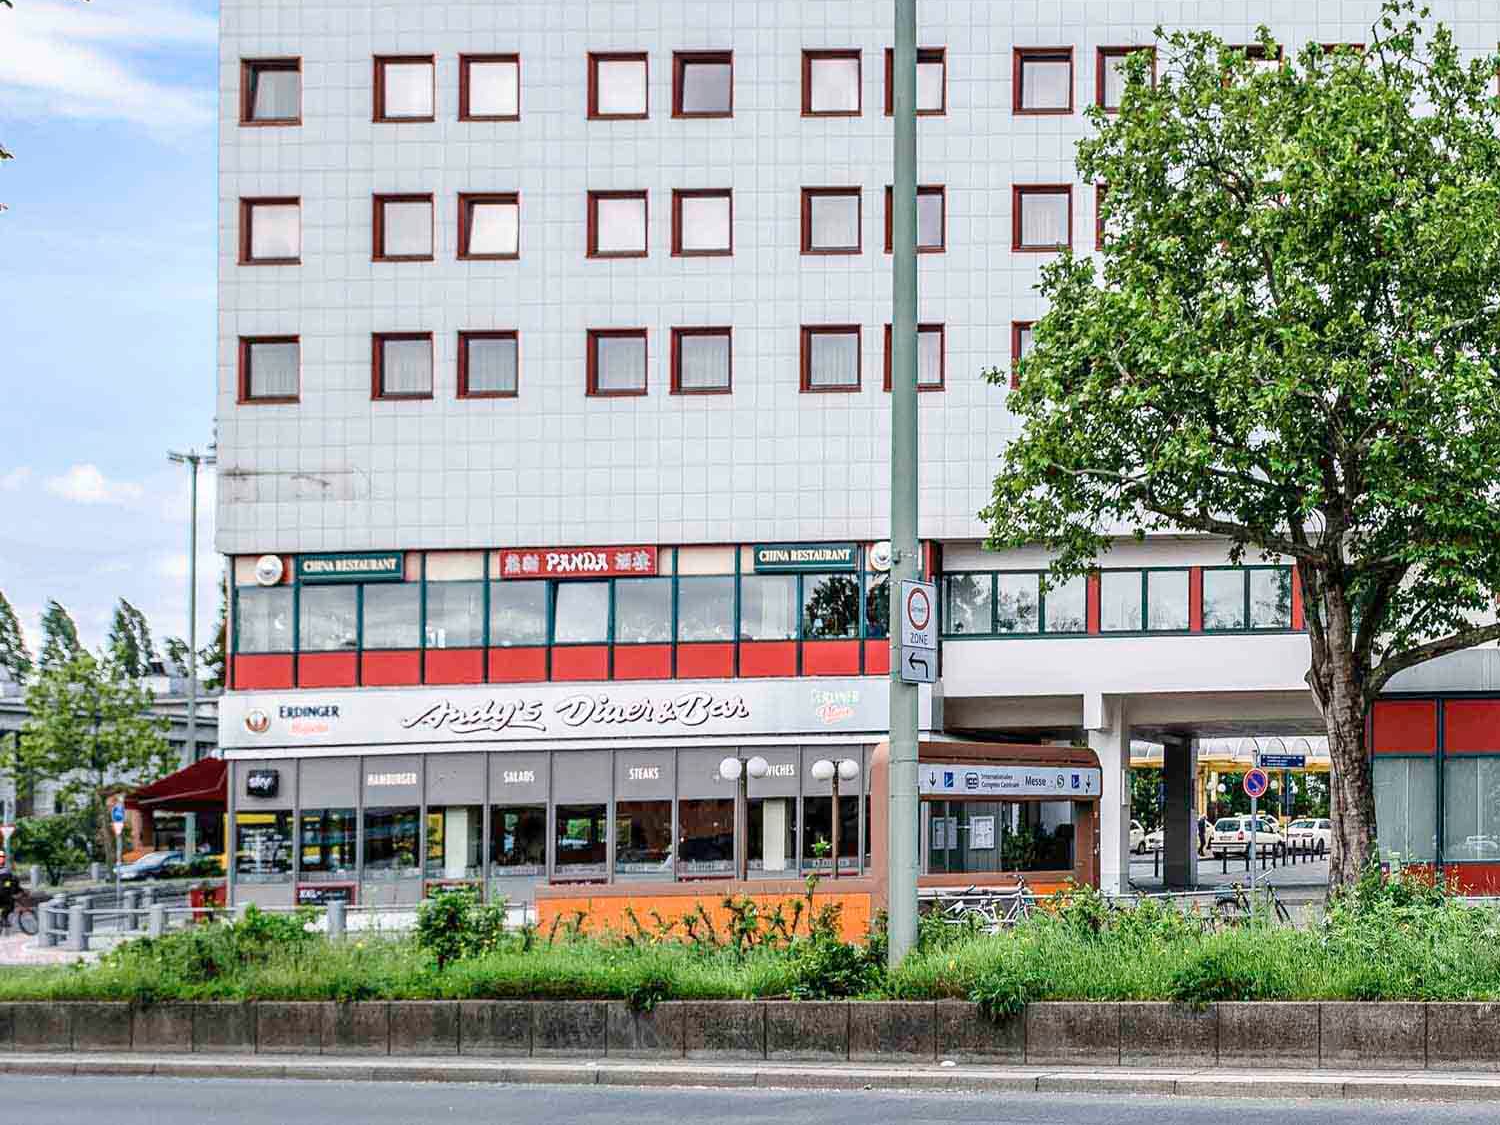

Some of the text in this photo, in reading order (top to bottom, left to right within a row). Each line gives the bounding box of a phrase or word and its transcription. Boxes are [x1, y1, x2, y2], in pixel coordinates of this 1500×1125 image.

[545, 551, 609, 572] PANDA
[759, 549, 851, 562] CHINA RESTAURANT
[303, 558, 397, 572] CHINA RESTAURANT
[911, 633, 928, 645] ZONE
[279, 705, 340, 719] ERDINGER
[401, 692, 750, 734] Andy's Diner & Bar
[367, 773, 417, 786] HAMBURGER
[503, 770, 535, 783] SALADS
[629, 767, 659, 780] STEAKS
[249, 774, 272, 790] sky
[1025, 776, 1047, 787] Messe
